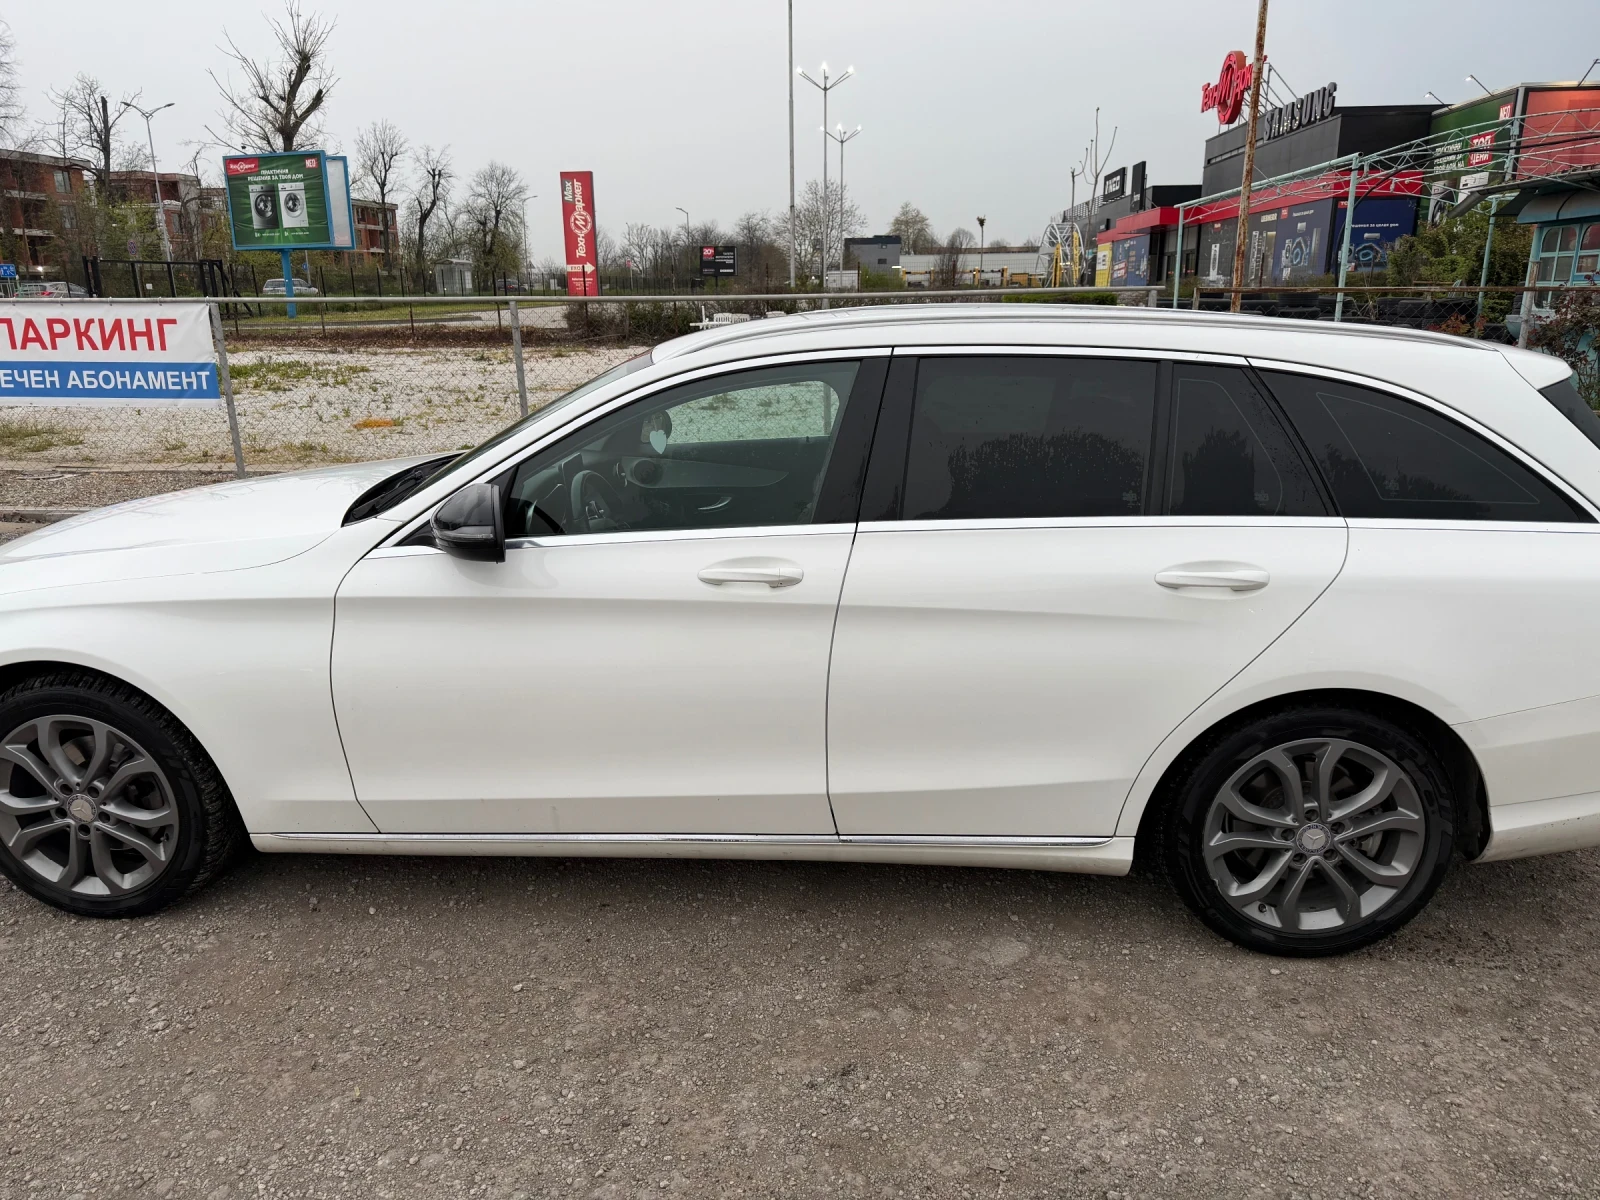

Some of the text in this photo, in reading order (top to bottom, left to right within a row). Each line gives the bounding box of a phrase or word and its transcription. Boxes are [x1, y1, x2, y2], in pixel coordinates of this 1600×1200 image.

[1264, 82, 1337, 141] SAMSUNG
[1473, 135, 1491, 149] ТОП
[306, 160, 316, 168] NEO
[564, 181, 573, 202] Max
[67, 370, 210, 390] АБОНАМЕНТ
